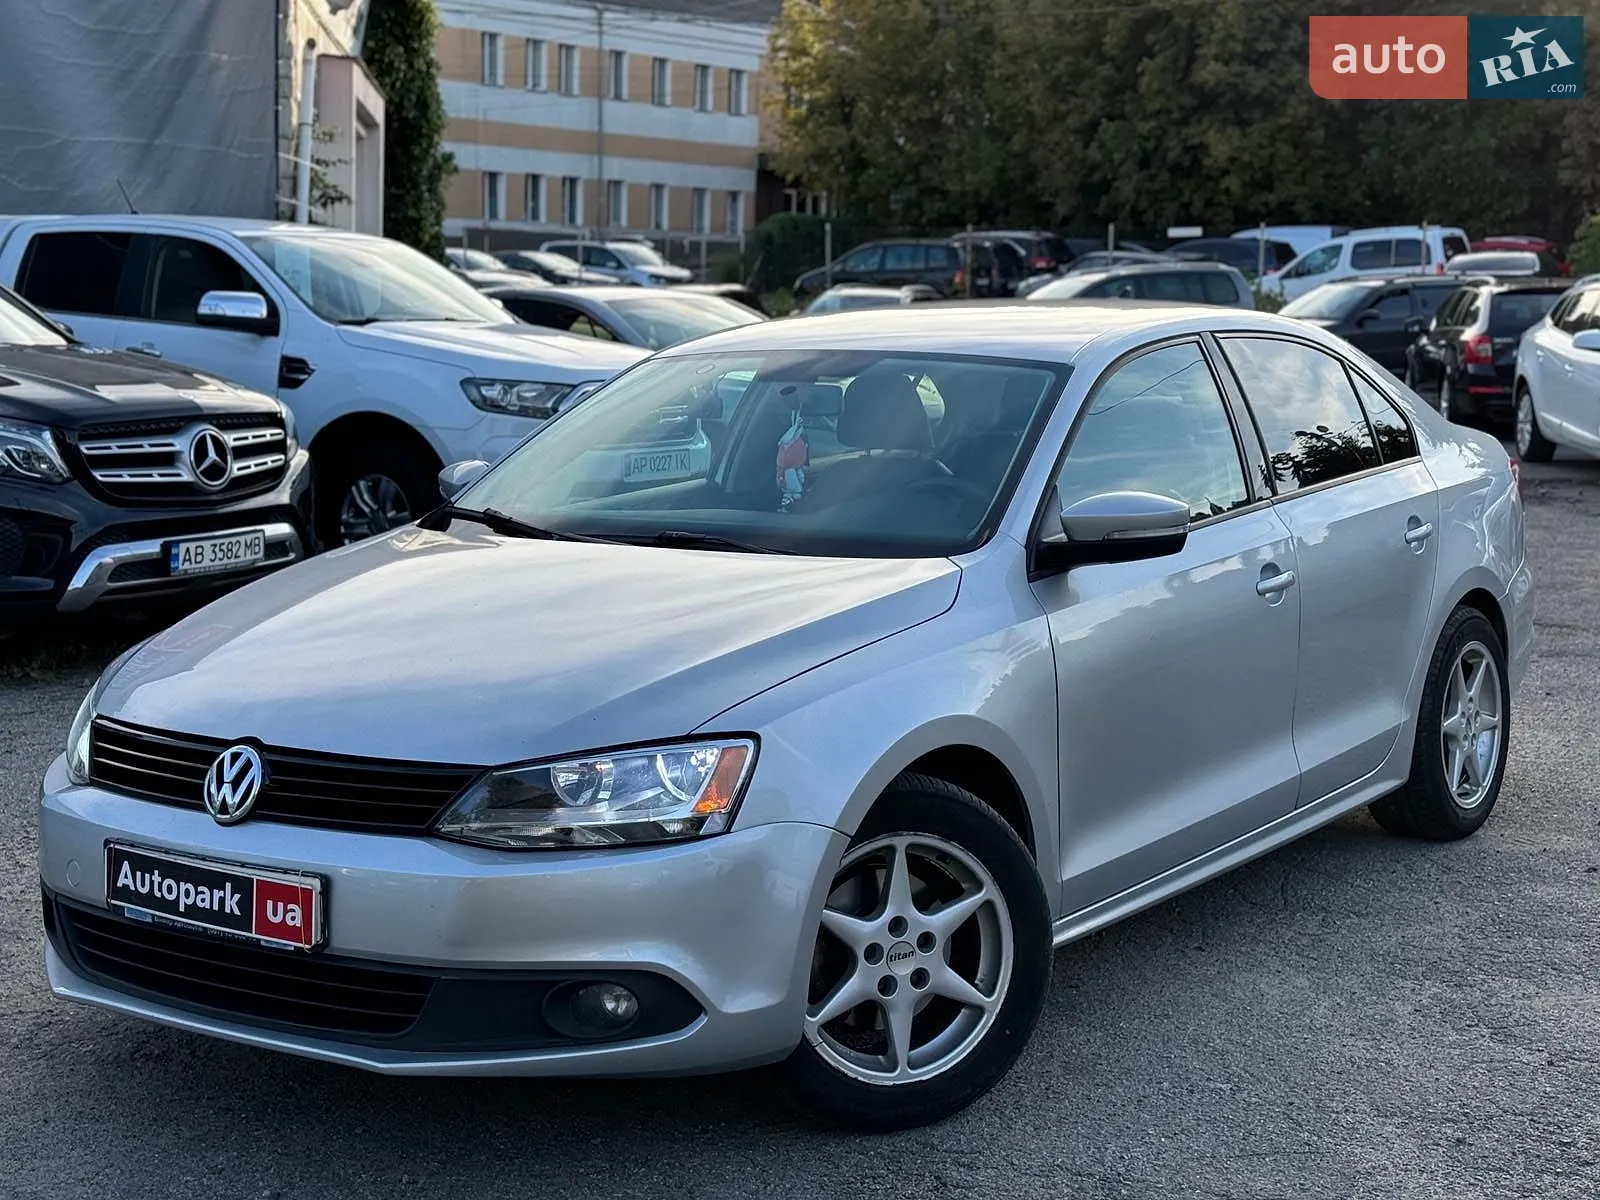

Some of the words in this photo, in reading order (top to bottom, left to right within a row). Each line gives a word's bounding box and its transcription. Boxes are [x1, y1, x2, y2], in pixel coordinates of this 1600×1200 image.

[632, 456, 647, 473] AP
[649, 454, 672, 472] 0227
[181, 545, 205, 566] AB
[209, 540, 241, 562] 3582
[243, 536, 261, 557] MB
[116, 860, 242, 916] Autopark
[266, 900, 302, 928] ua
[889, 950, 915, 963] titan
